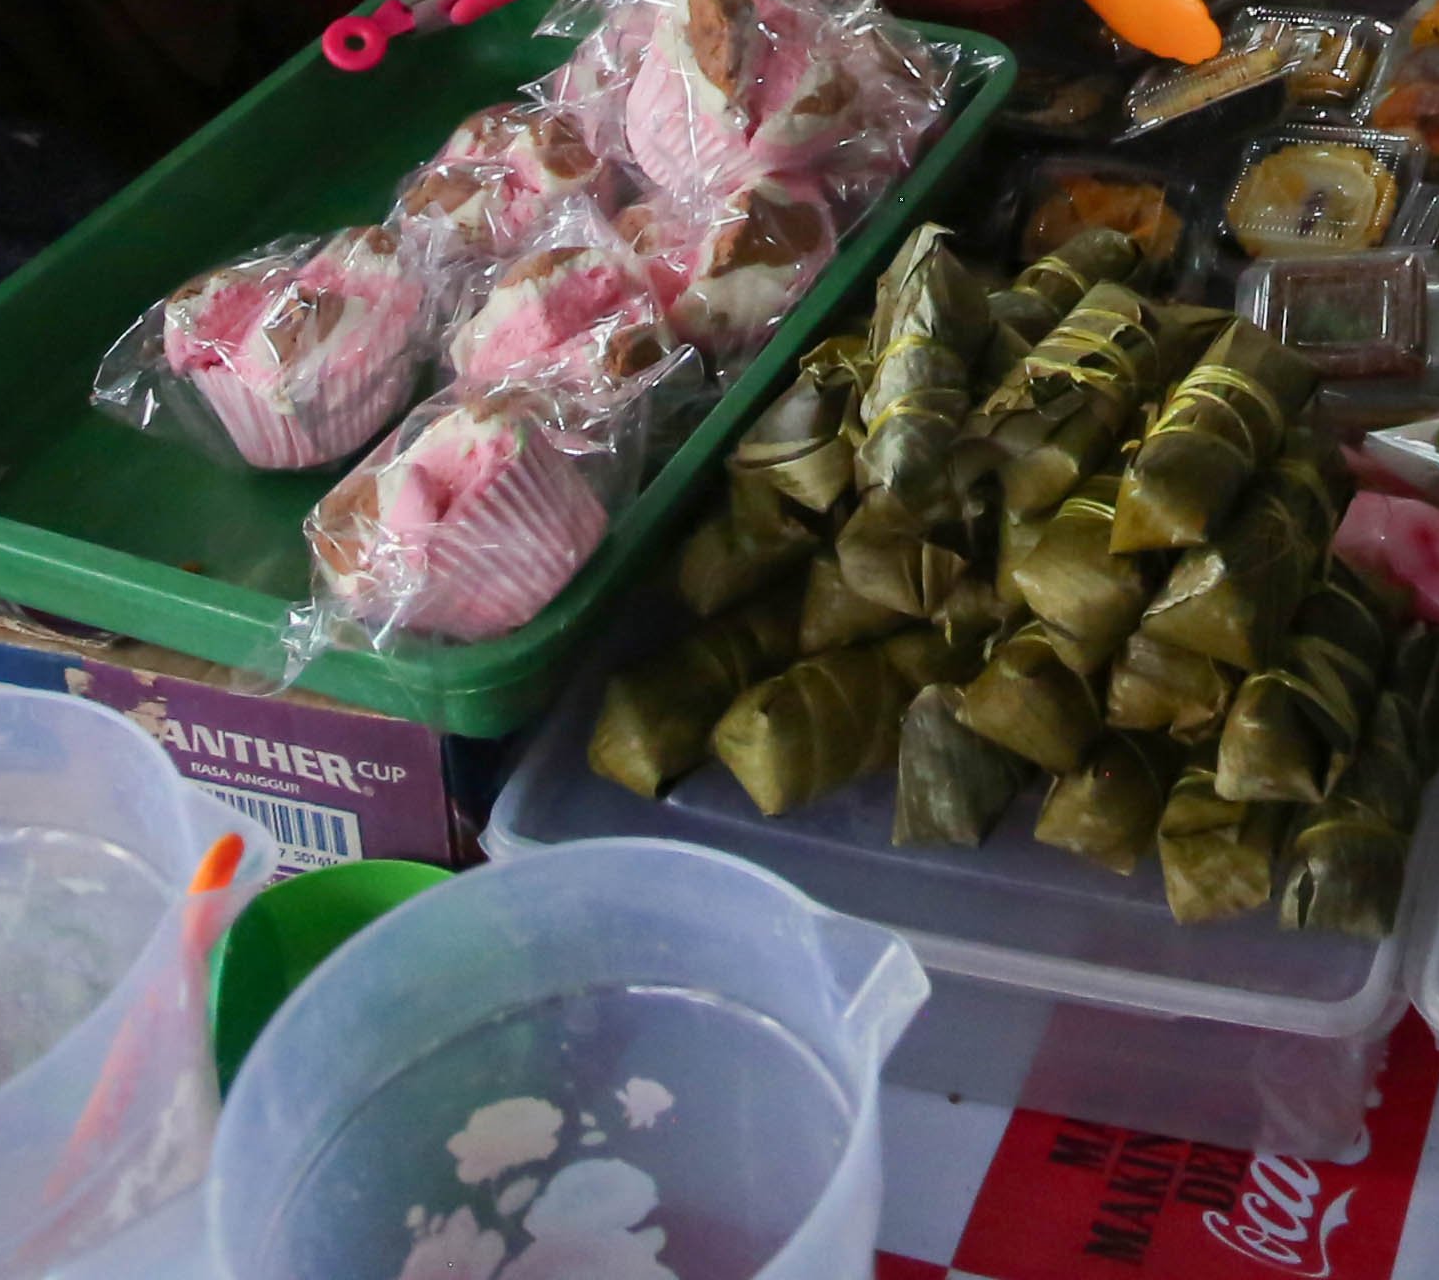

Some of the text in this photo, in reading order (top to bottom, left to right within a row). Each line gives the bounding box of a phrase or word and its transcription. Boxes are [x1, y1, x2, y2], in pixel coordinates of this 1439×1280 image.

[161, 719, 406, 794] ANTHER CUP
[190, 762, 301, 794] RASA ANGGUR
